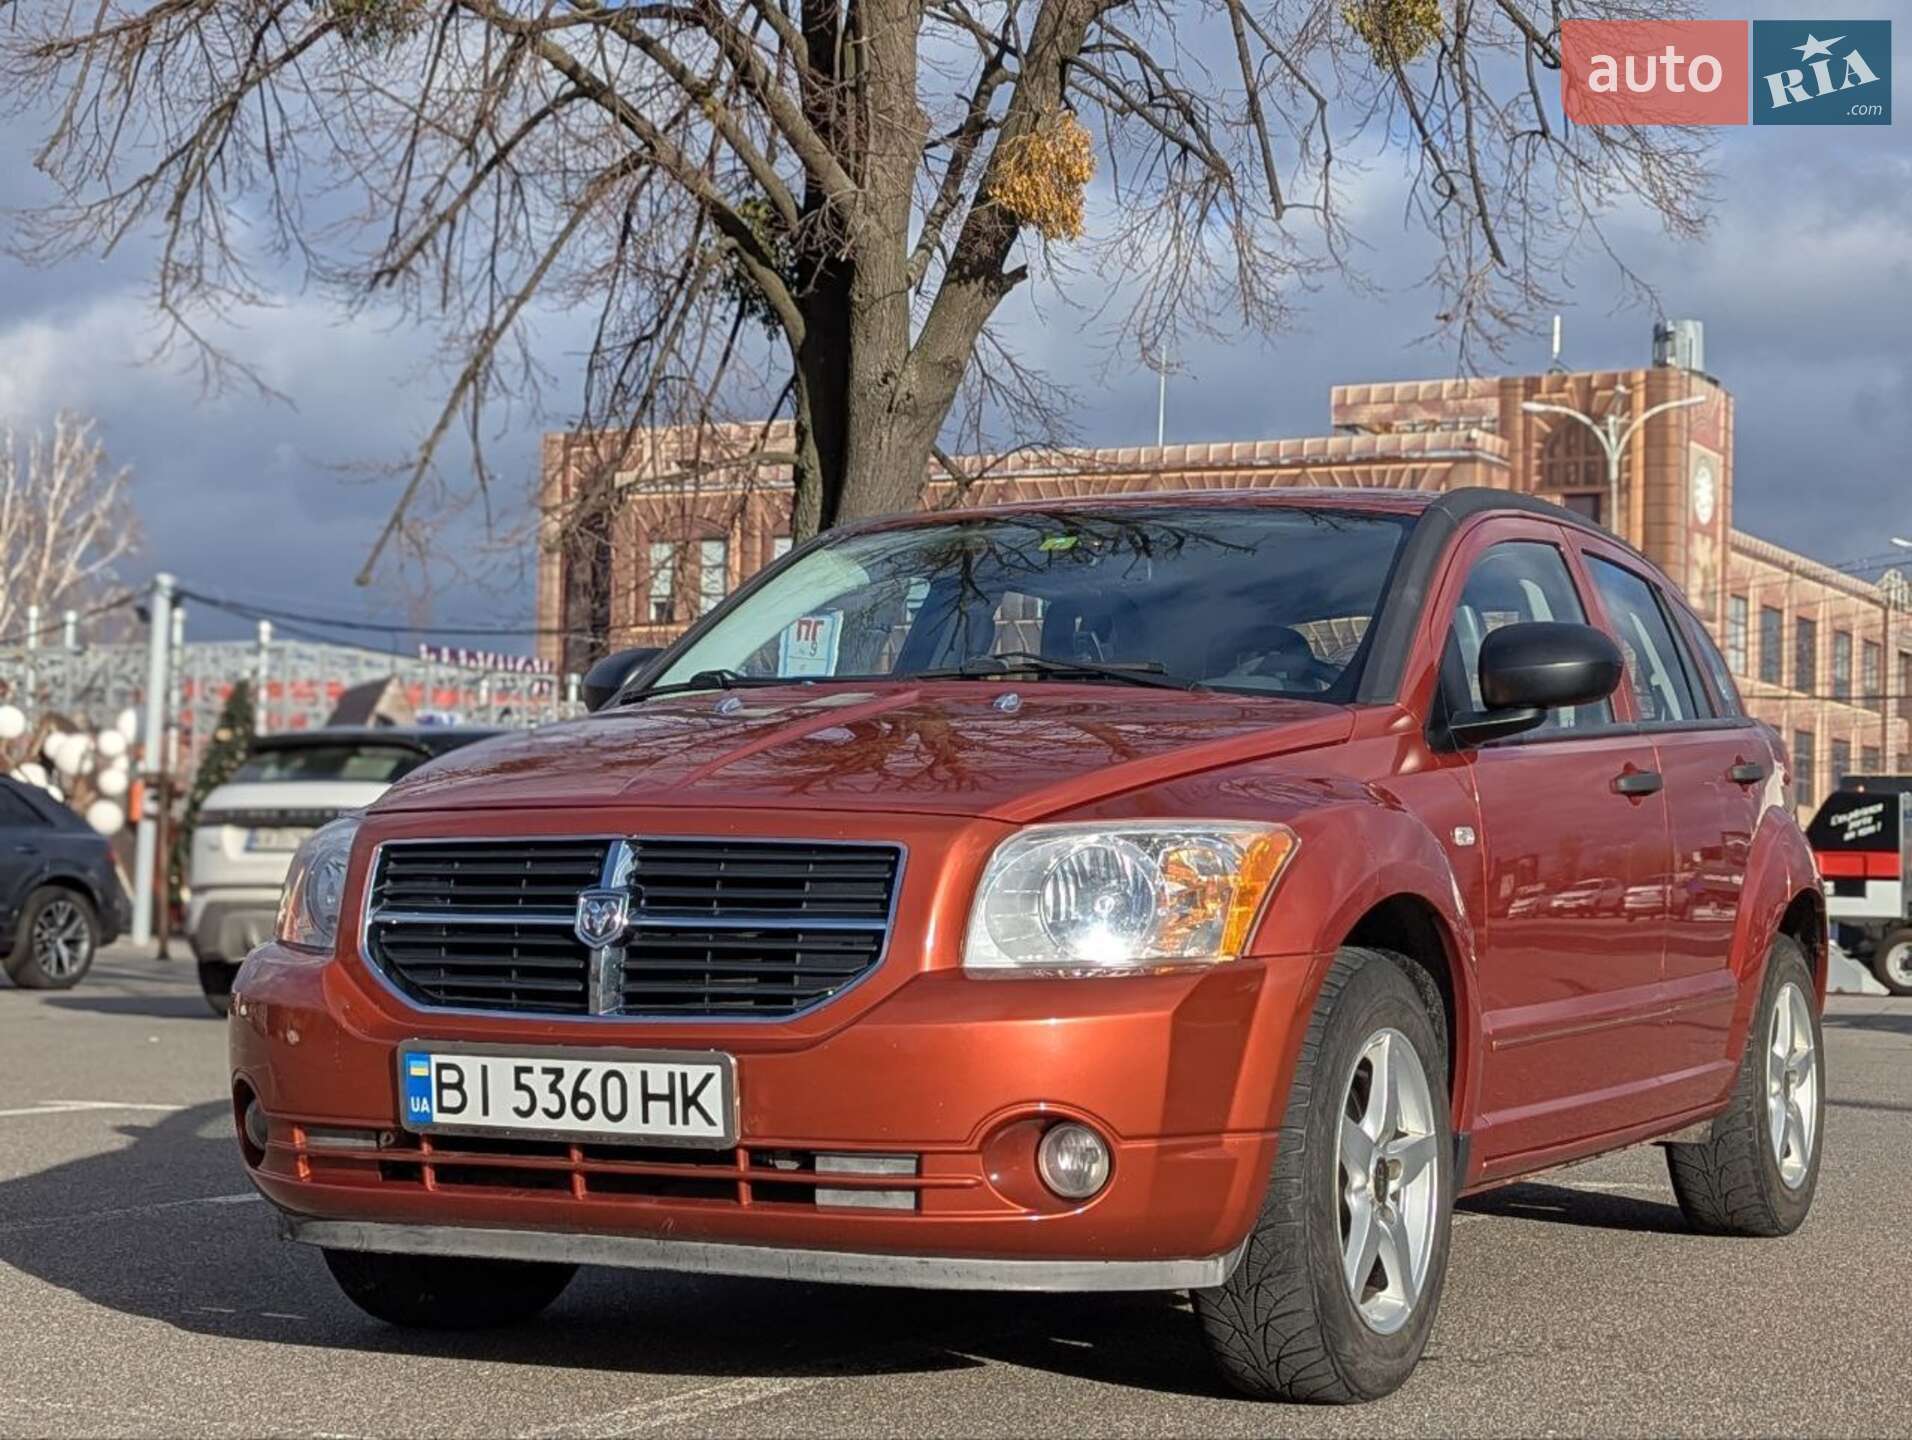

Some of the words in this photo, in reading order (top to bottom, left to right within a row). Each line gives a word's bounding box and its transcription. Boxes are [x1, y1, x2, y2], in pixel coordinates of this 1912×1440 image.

[410, 1096, 431, 1114] UA
[435, 1062, 490, 1117] BI
[512, 1066, 628, 1123] 5360
[641, 1070, 718, 1127] HK
